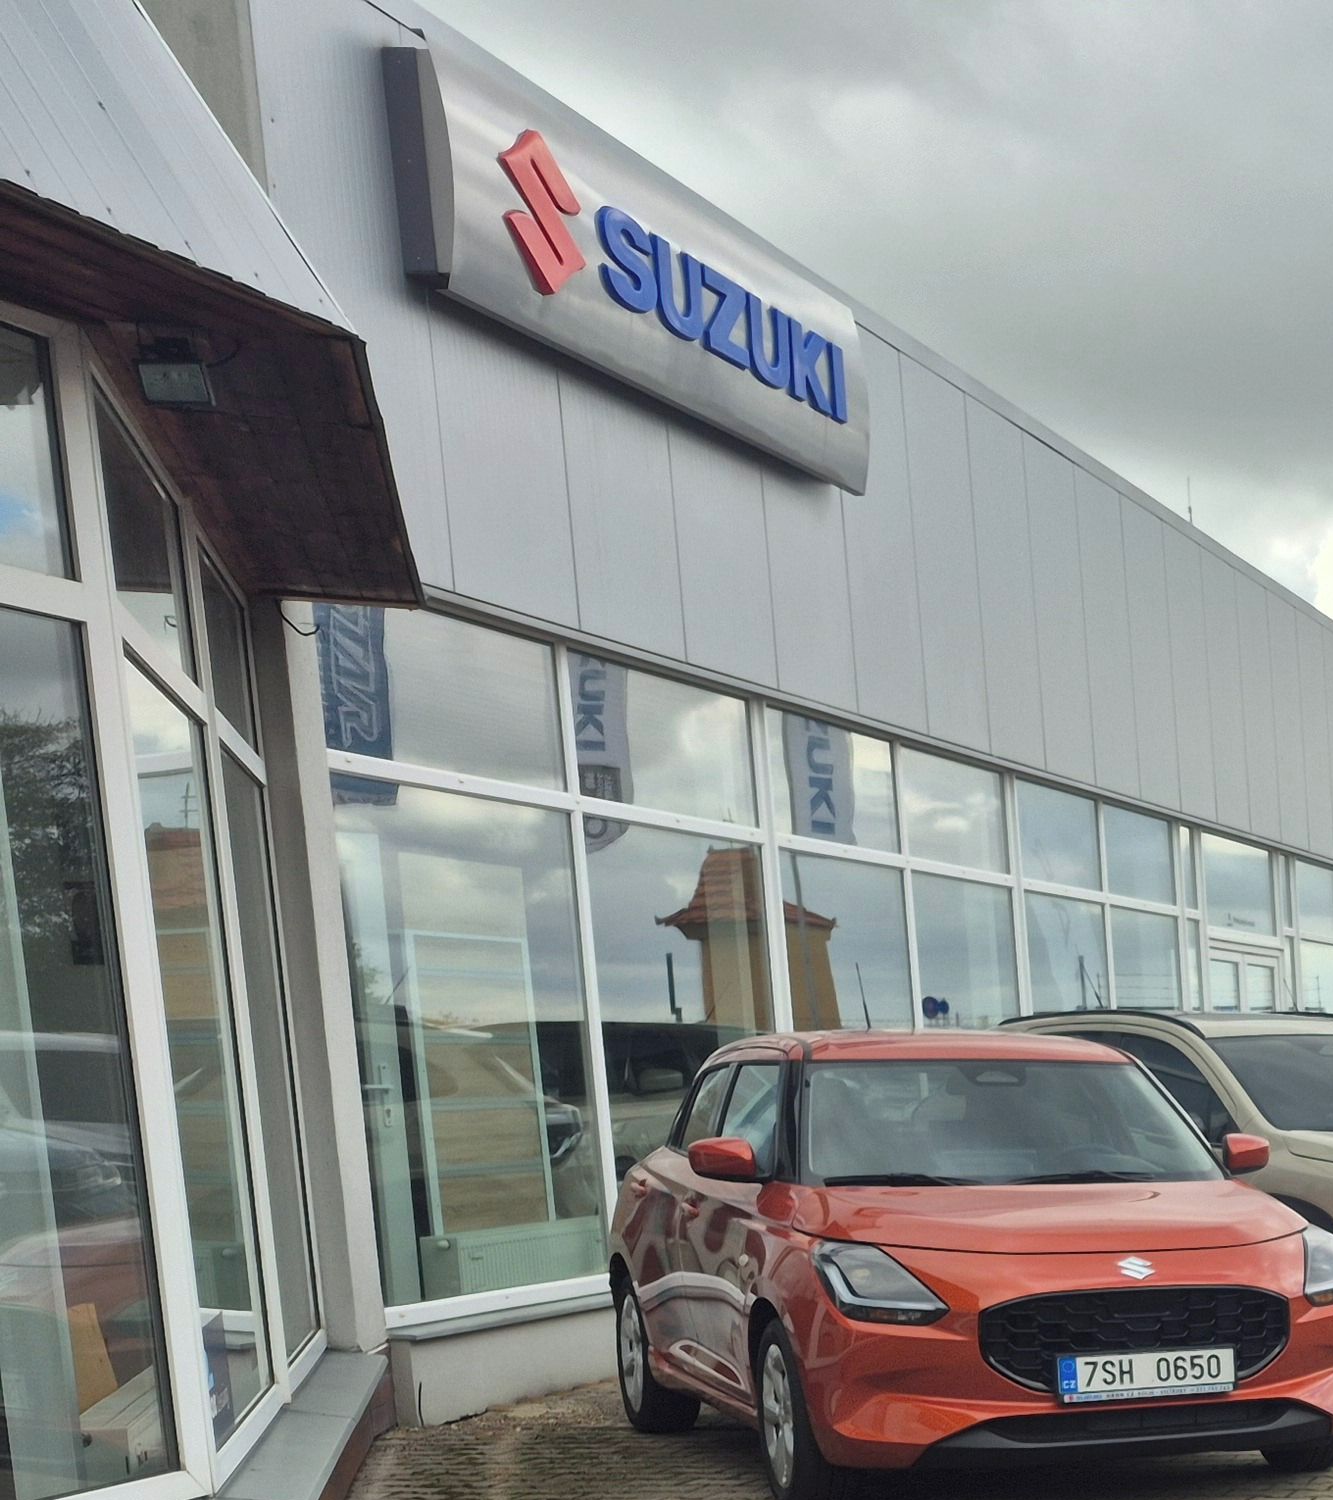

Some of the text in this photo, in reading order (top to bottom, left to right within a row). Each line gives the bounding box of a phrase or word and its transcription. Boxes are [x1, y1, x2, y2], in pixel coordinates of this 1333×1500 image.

[595, 205, 848, 425] SUZUKI
[1062, 1380, 1077, 1389] CZ
[1084, 1353, 1222, 1388] 7SH 0650
